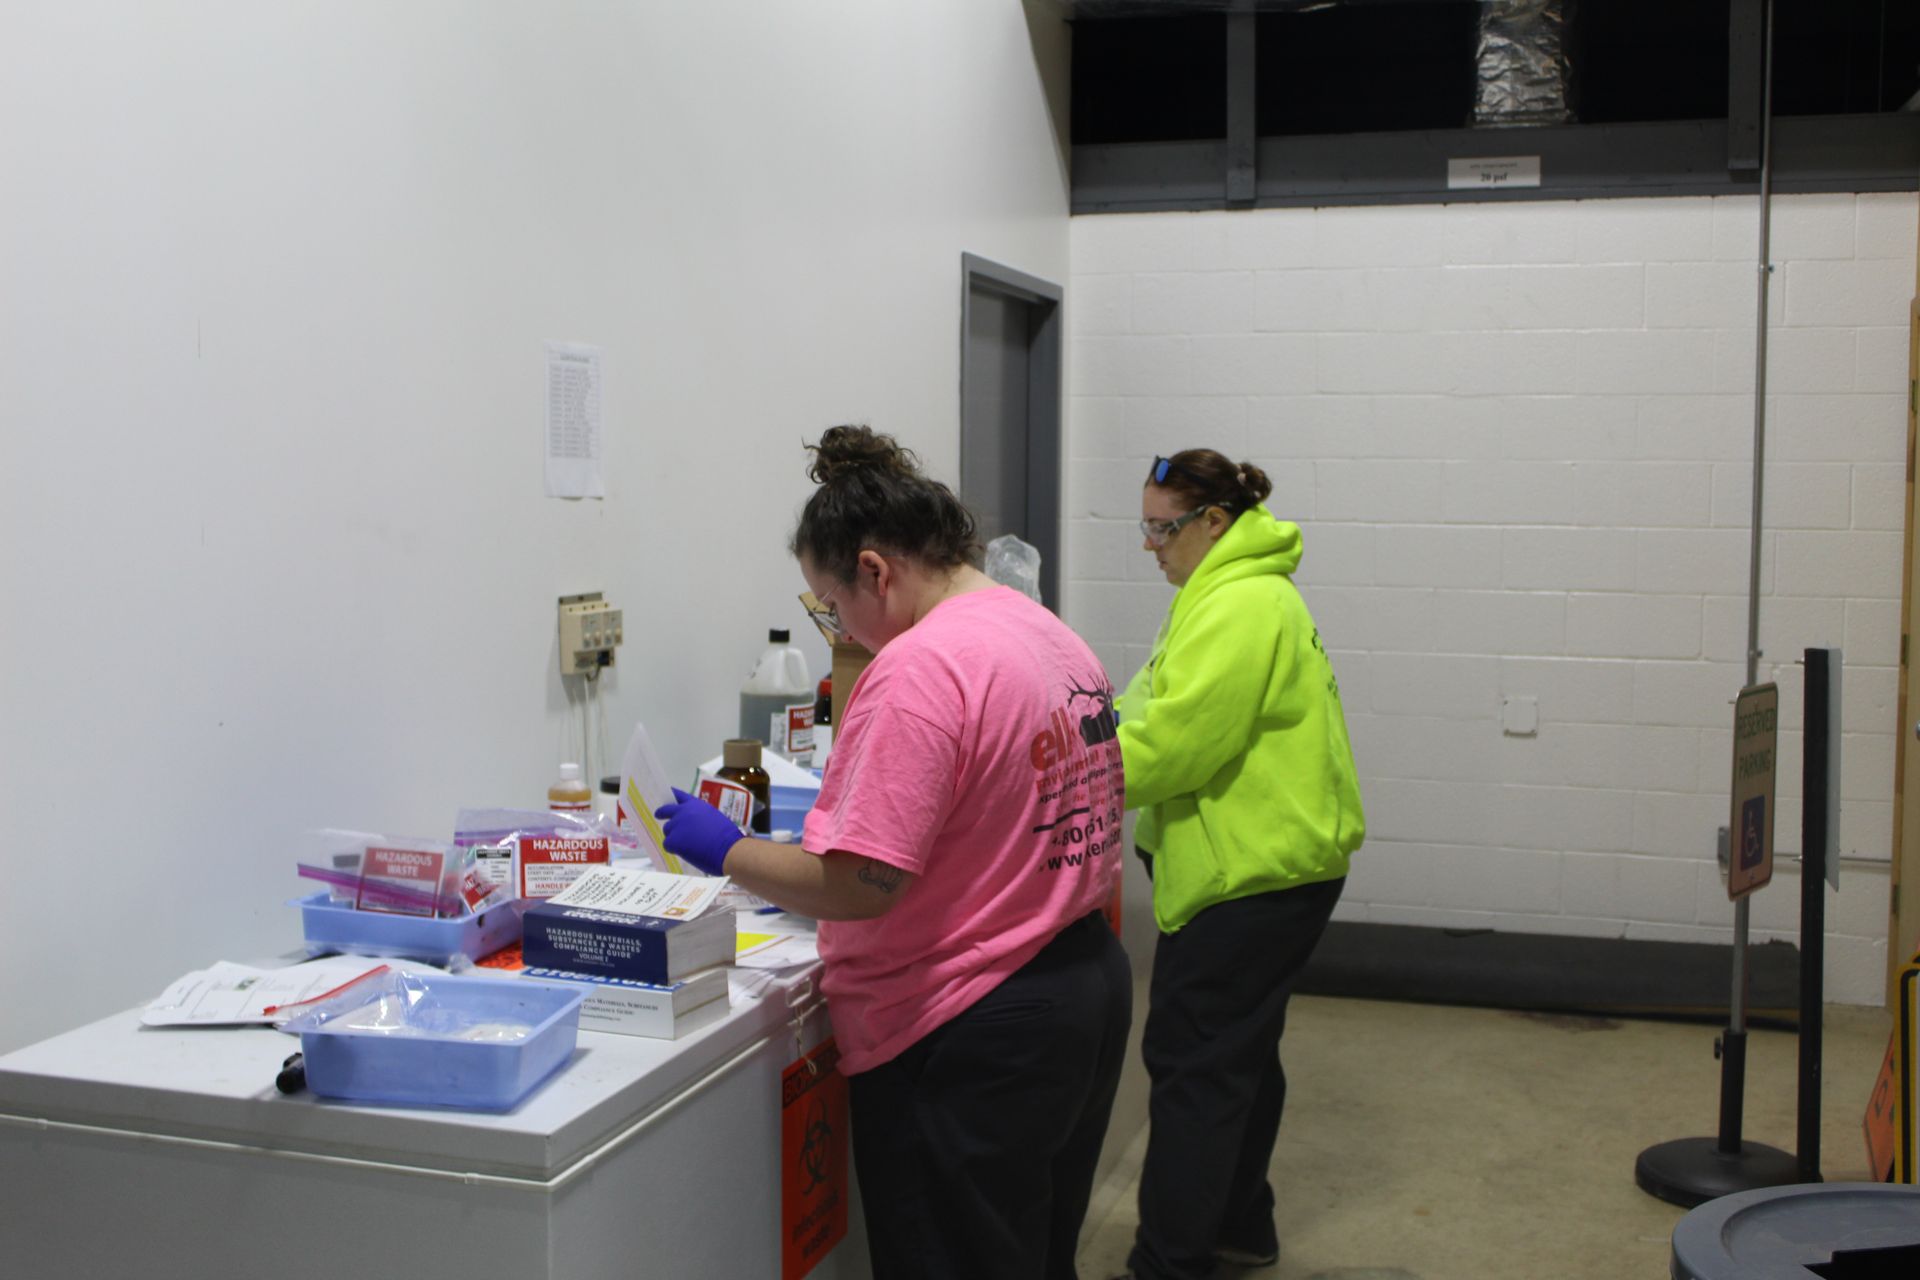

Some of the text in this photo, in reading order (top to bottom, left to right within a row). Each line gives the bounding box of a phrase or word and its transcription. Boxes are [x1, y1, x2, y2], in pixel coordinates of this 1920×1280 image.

[533, 839, 604, 850] HAZARDOUS
[375, 851, 433, 867] HAZARDOUS
[549, 851, 588, 862] WASTE
[387, 864, 419, 877] WASTE
[546, 927, 642, 947] HAZARDOUS MATERIALS,
[548, 935, 597, 947] SUBSTANCES
[608, 943, 640, 953] WASTES
[554, 942, 631, 959] COMPLIANCE GUIDE
[579, 953, 604, 962] VOLUME
